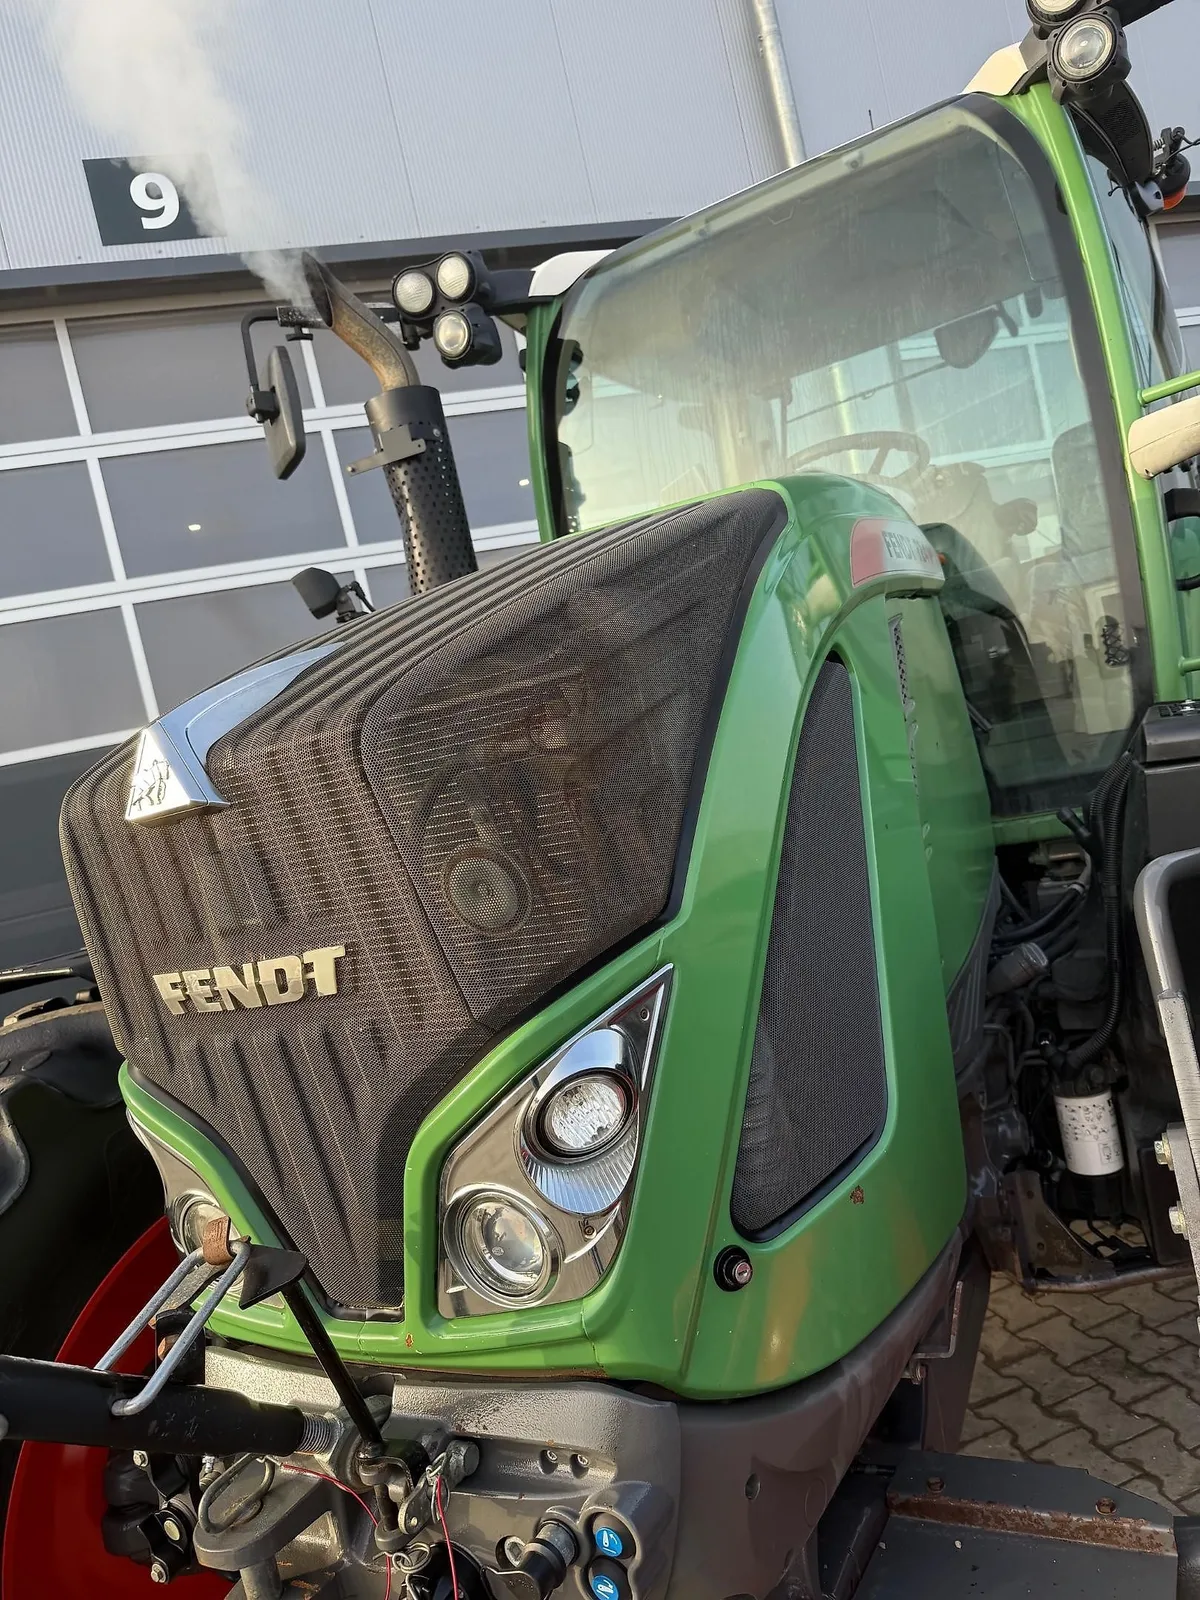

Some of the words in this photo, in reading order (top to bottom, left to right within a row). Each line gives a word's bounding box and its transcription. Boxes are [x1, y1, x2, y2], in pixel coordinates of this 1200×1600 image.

[130, 172, 180, 230] 9
[881, 530, 917, 561] FENDT
[152, 945, 346, 1016] FENDT
